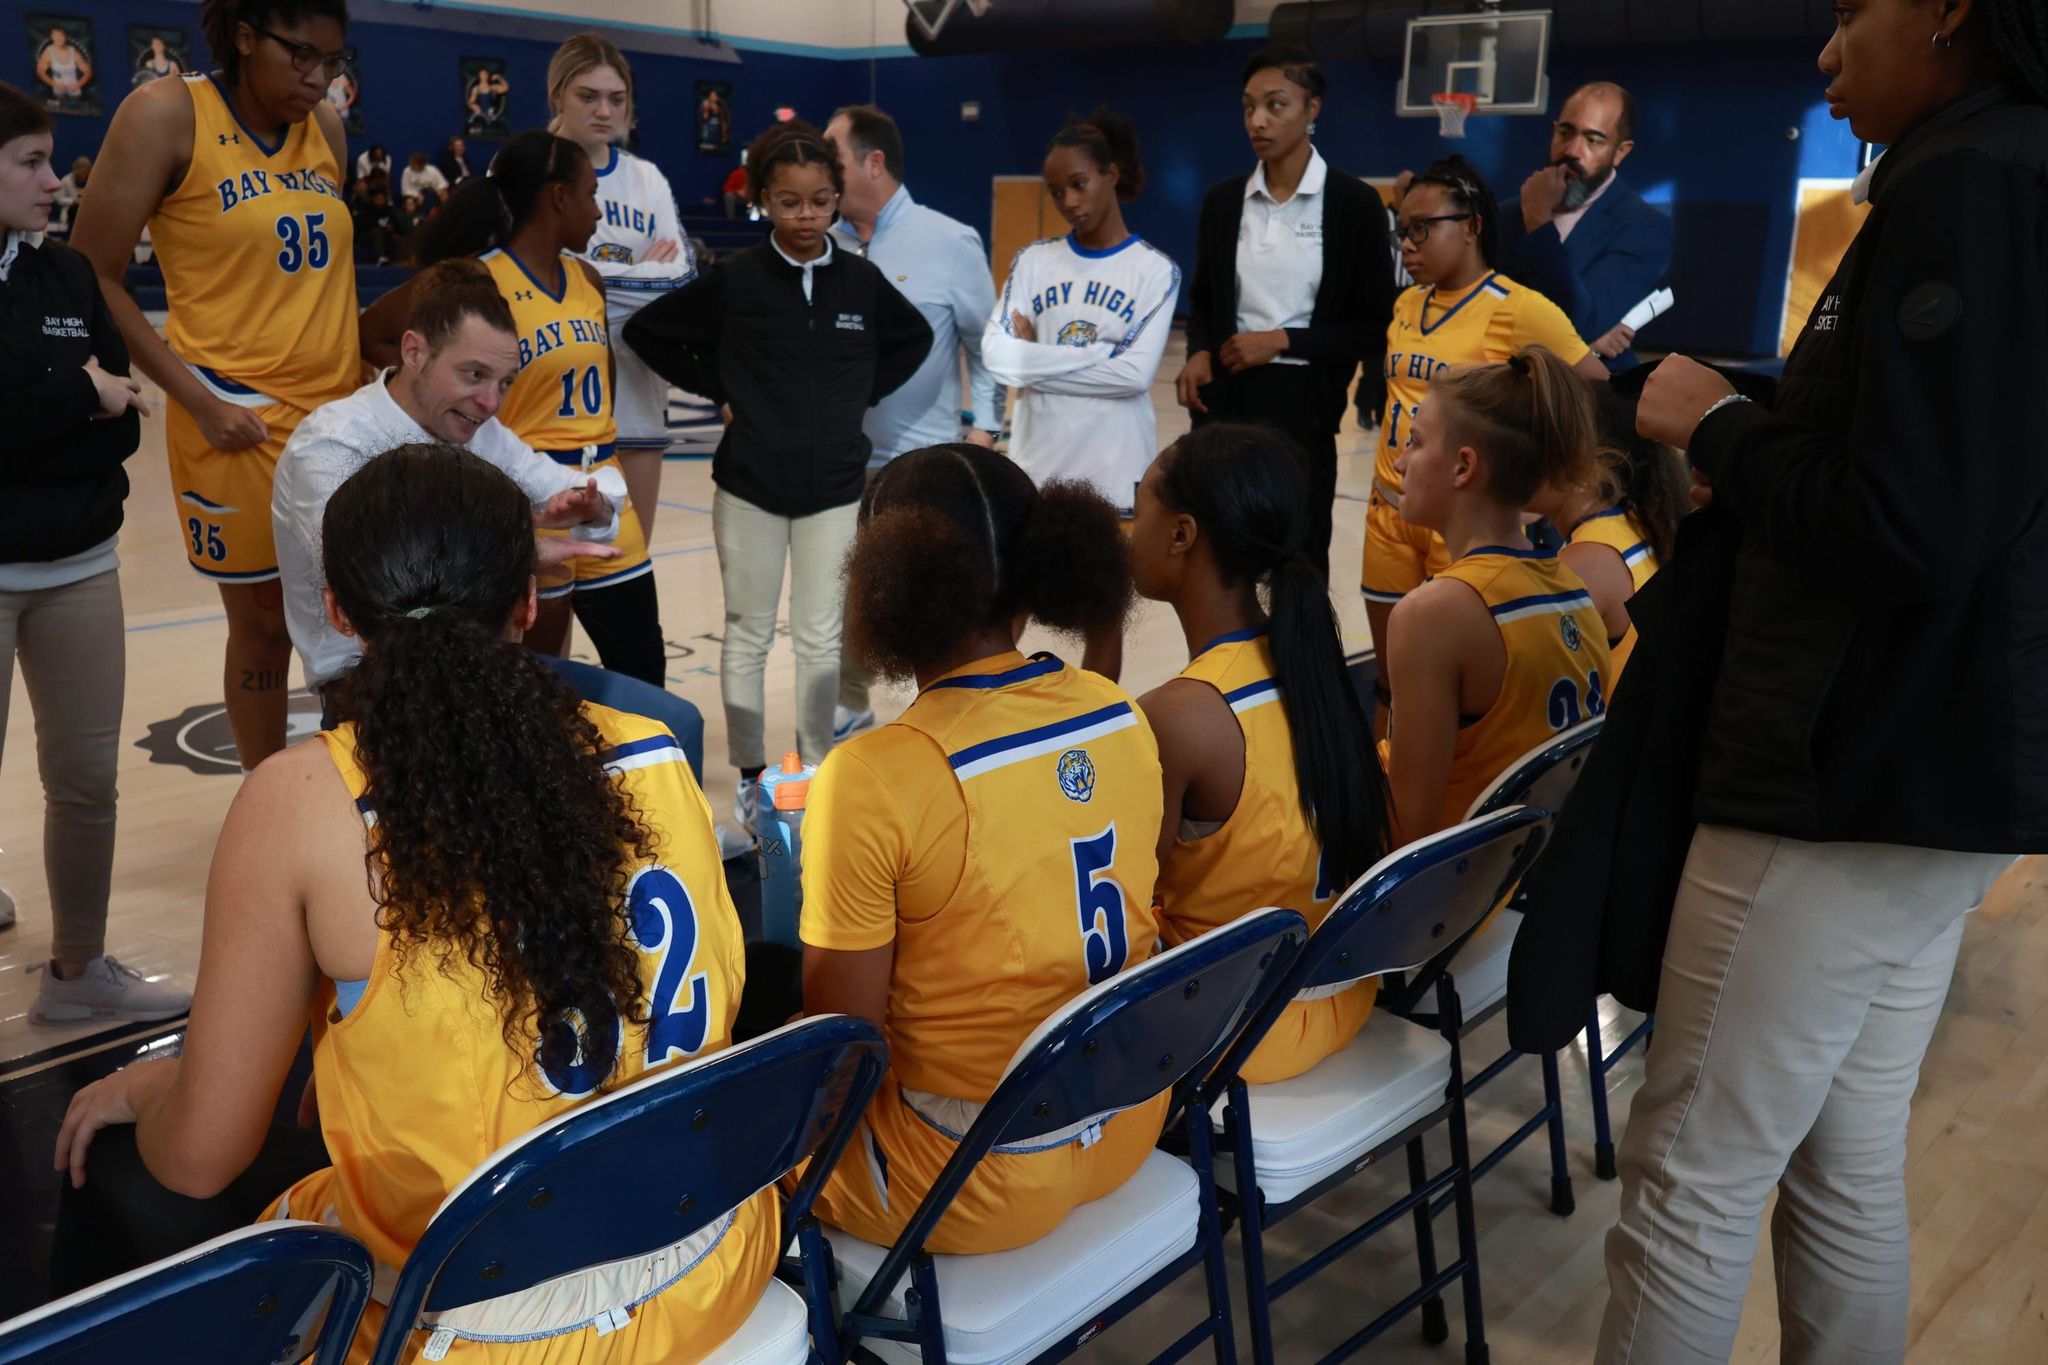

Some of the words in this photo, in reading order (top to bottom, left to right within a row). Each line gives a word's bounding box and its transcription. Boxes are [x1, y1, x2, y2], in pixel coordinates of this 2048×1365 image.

[217, 168, 272, 213] BAY
[275, 211, 331, 274] 35
[62, 317, 84, 327] HIGH
[1032, 281, 1073, 316] BAY
[1083, 280, 1138, 324] HIGH
[41, 325, 90, 338] BASKETBALL
[517, 320, 565, 371] BAY
[557, 364, 602, 417] 10
[188, 516, 228, 563] 35
[1069, 819, 1129, 987] 5
